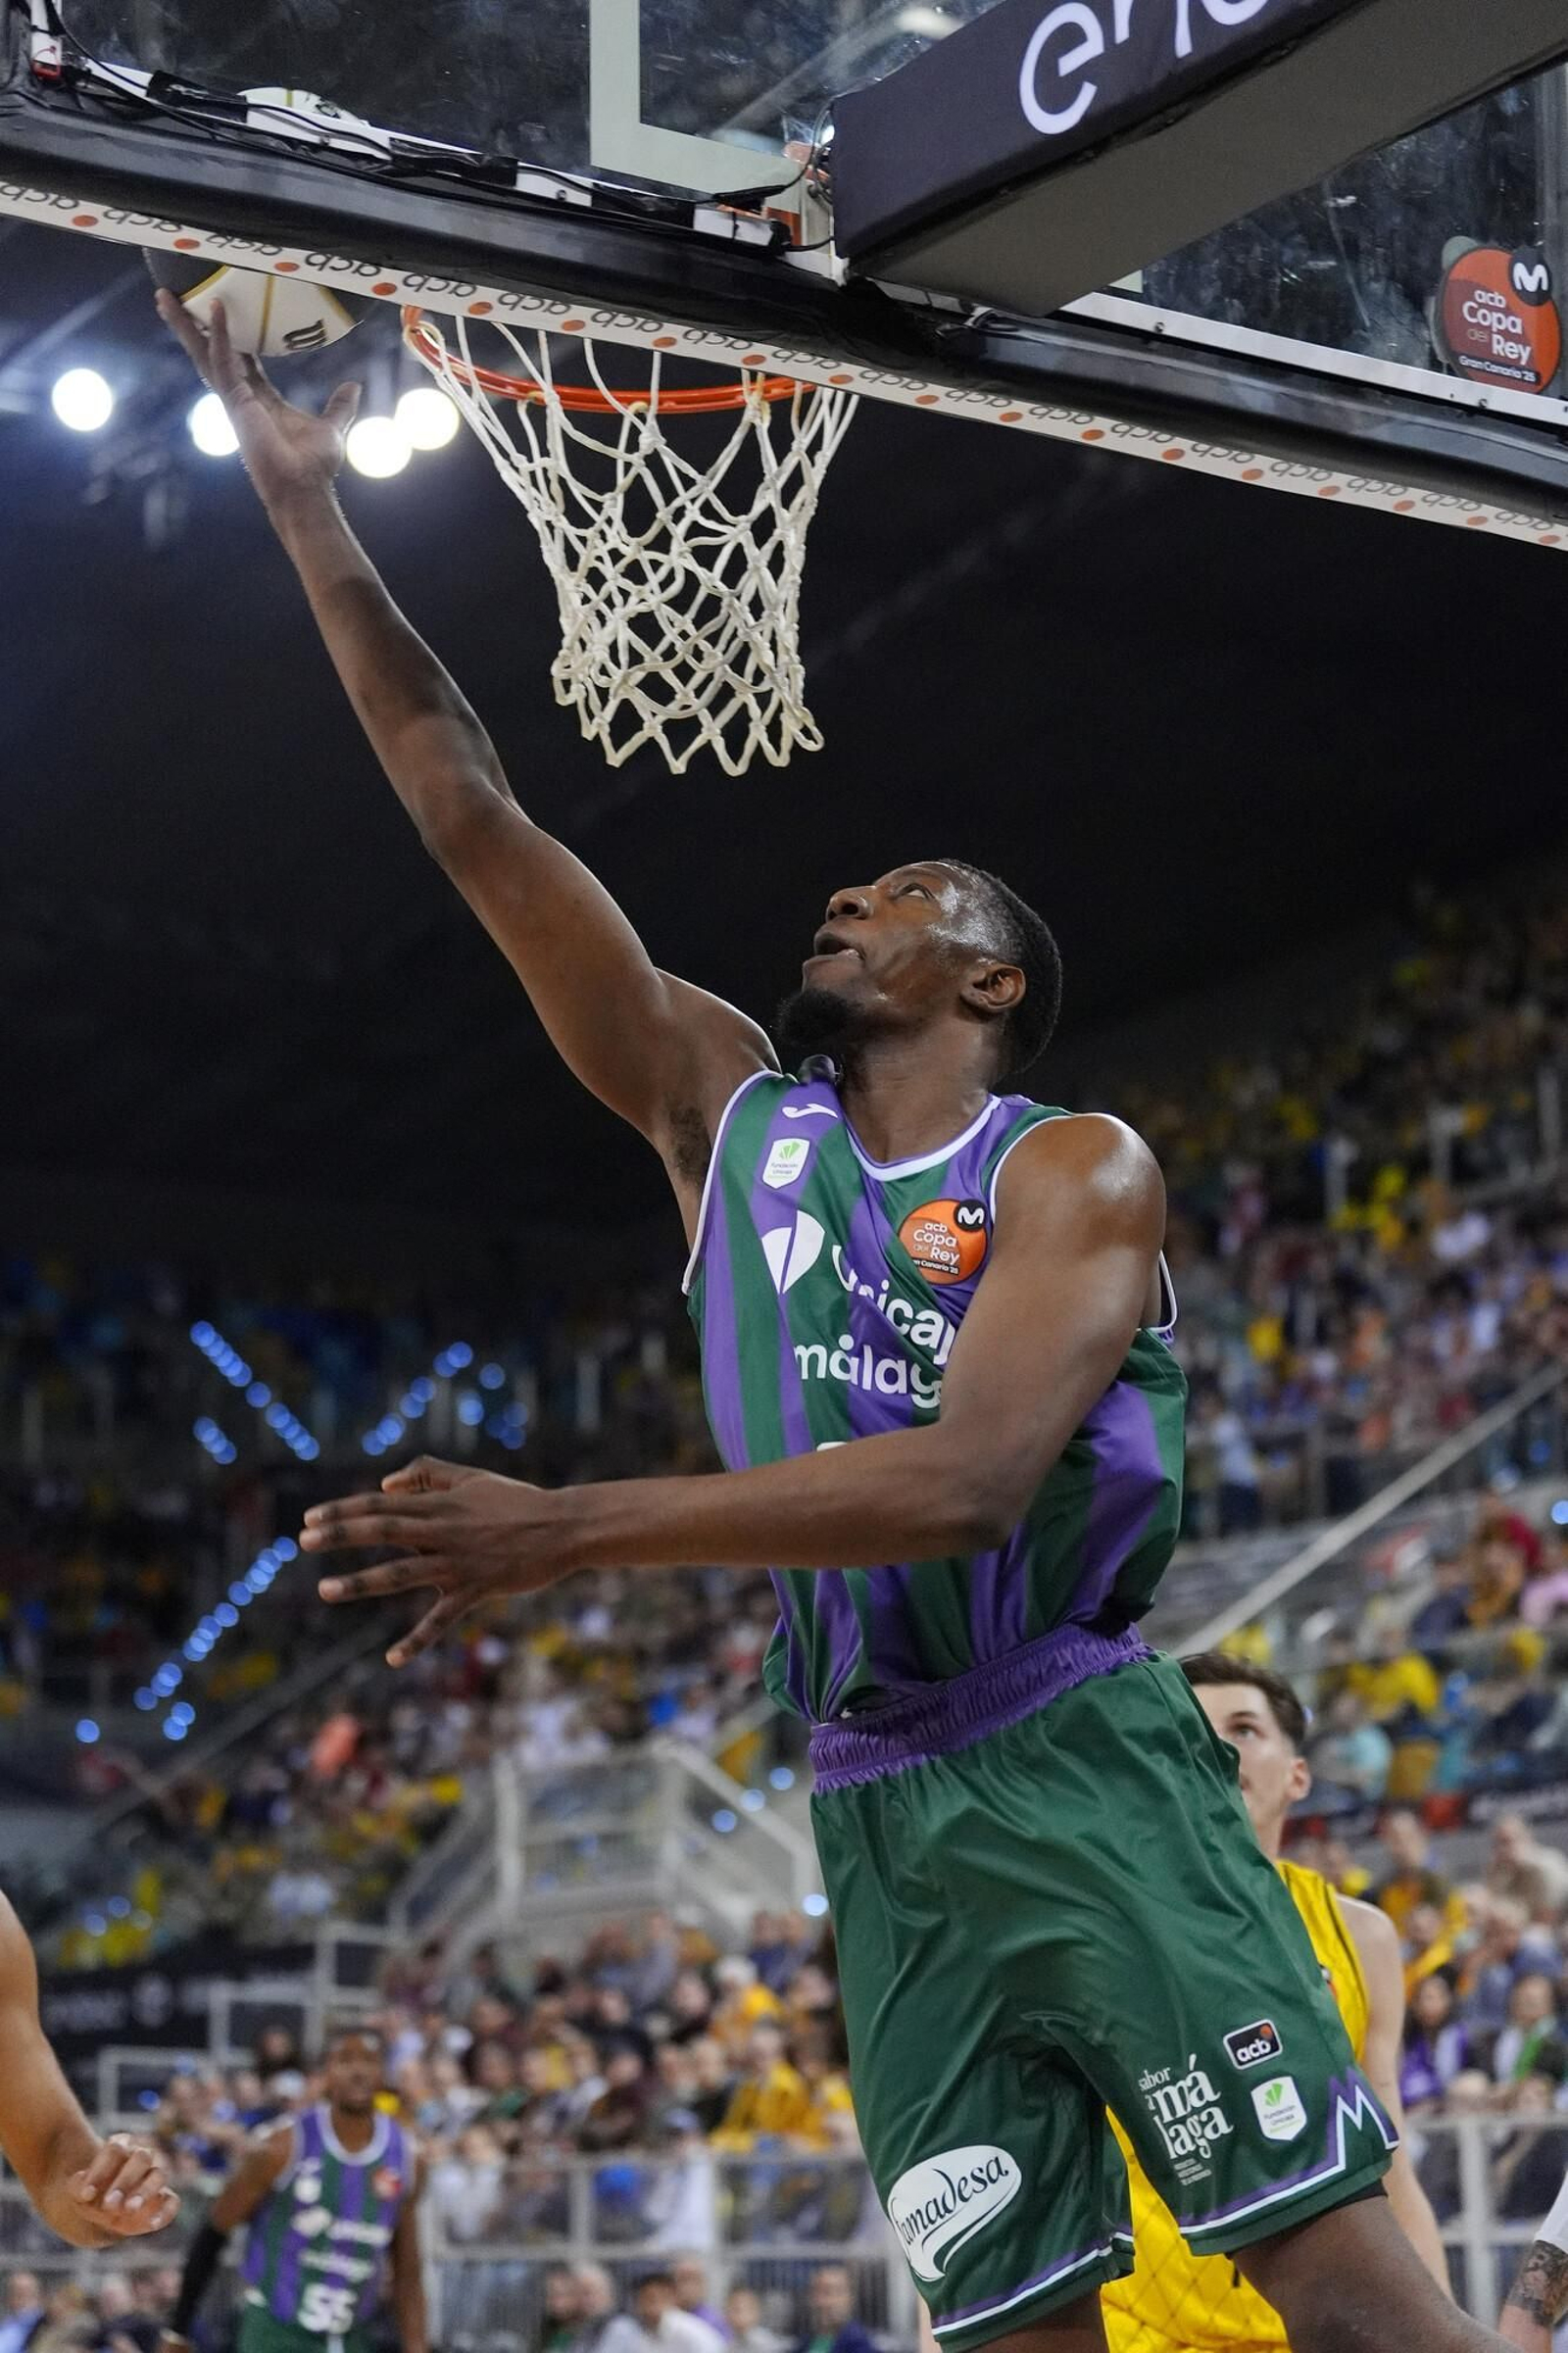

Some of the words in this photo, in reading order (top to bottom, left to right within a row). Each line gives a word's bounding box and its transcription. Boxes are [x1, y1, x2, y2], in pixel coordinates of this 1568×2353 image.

[1474, 290, 1506, 308] acb
[1462, 301, 1523, 334] Copa
[1492, 334, 1531, 366] Rey
[924, 1222, 948, 1233] acb
[913, 1229, 957, 1248] Copa
[930, 1247, 960, 1265] Rey
[794, 1334, 942, 1409] málag
[1237, 2038, 1271, 2062] acb
